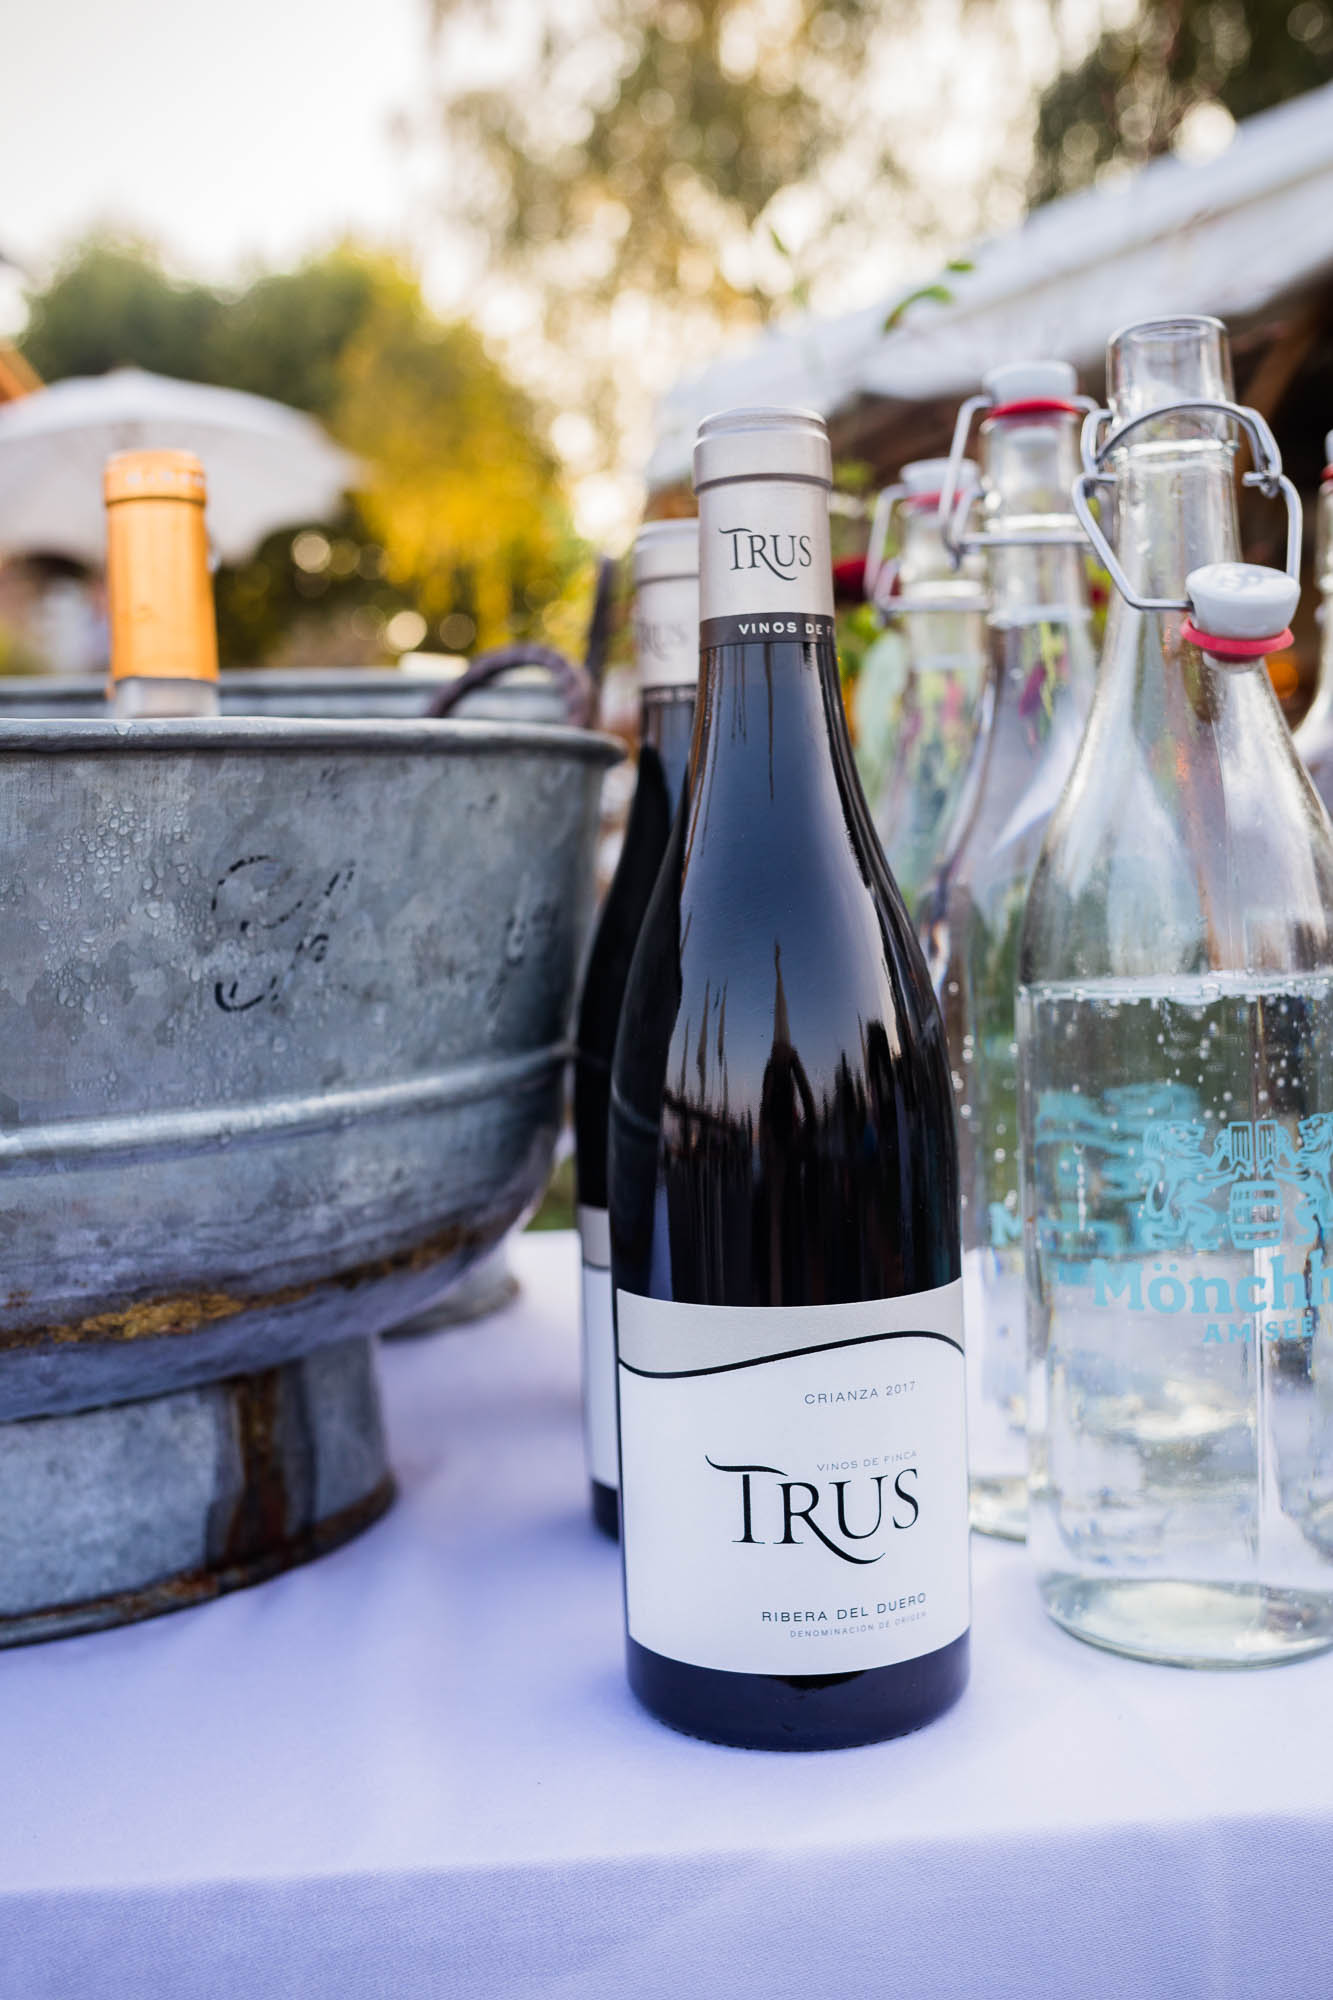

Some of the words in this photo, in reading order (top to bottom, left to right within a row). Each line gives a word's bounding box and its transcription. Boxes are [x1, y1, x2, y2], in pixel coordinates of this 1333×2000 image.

[719, 527, 812, 581] TRUS
[738, 621, 797, 635] VINOS
[805, 622, 823, 635] DE
[1202, 1323, 1252, 1343] AM
[1265, 1317, 1314, 1341] SEE
[804, 1387, 879, 1405] CRIANZA
[885, 1380, 916, 1396] 2017
[816, 1460, 858, 1472] VINOS
[863, 1457, 880, 1468] DE
[884, 1450, 917, 1464] FINCA
[705, 1455, 920, 1565] TRUS
[761, 1610, 829, 1623] RIBERA
[836, 1606, 869, 1620] DEL
[876, 1592, 928, 1614] DUERO
[878, 1619, 891, 1630] DE
[894, 1610, 928, 1626] ORIGEN
